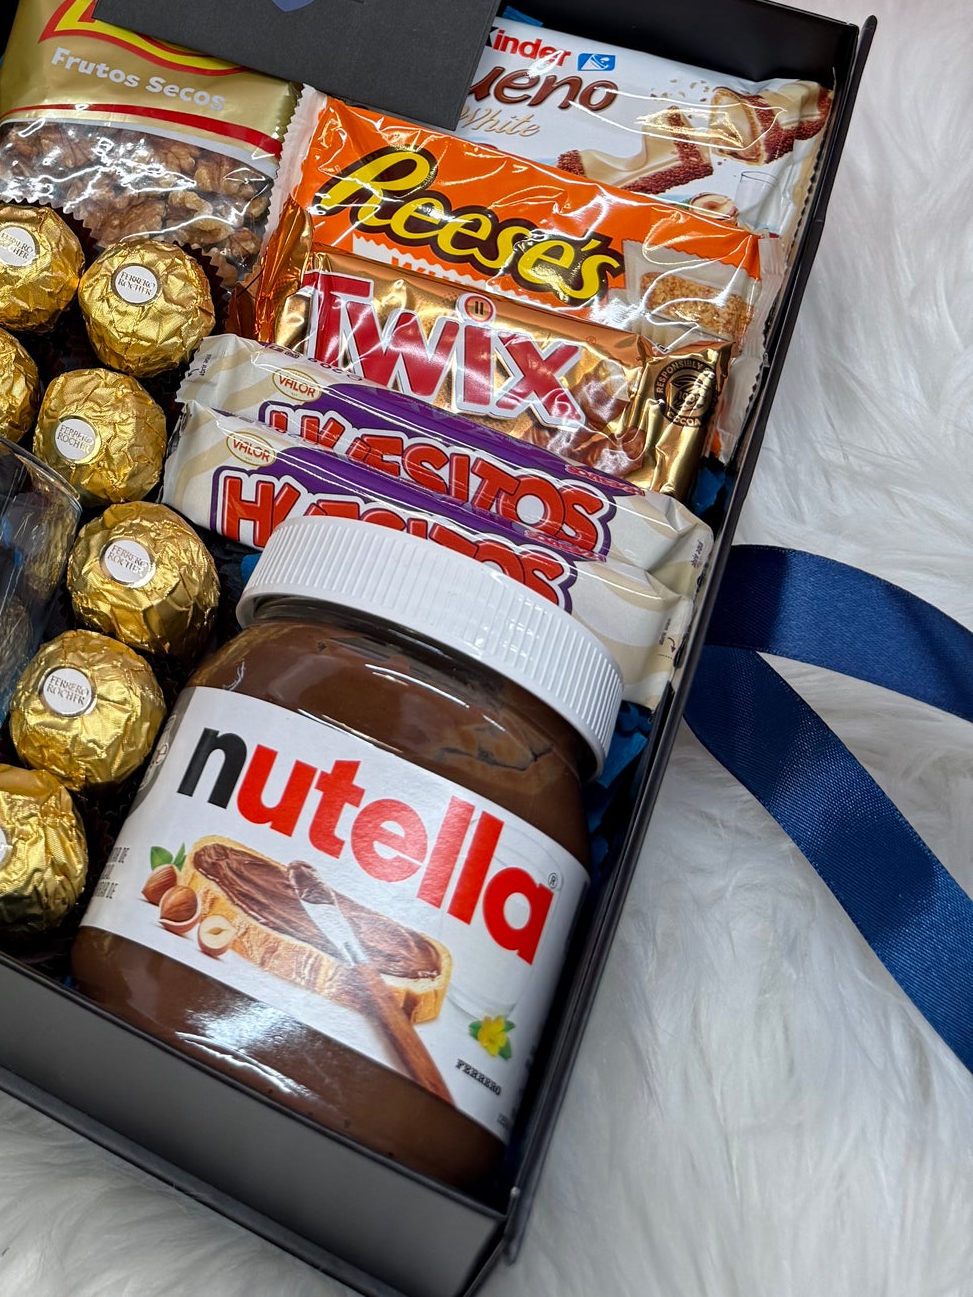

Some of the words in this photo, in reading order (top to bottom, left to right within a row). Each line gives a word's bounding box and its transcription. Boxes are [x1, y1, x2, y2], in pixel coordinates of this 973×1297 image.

[51, 47, 140, 88] Frutos
[145, 76, 226, 111] Secos
[468, 66, 619, 111] ueno
[315, 148, 623, 302] Reese's
[117, 278, 153, 297] ROCHER
[120, 271, 157, 289] FERRERO
[656, 360, 703, 394] RESPONSIBLY
[46, 684, 85, 705] ROCHER
[50, 675, 90, 697] FERRERO
[177, 727, 555, 966] nutella
[455, 1058, 502, 1096] FERRERO
